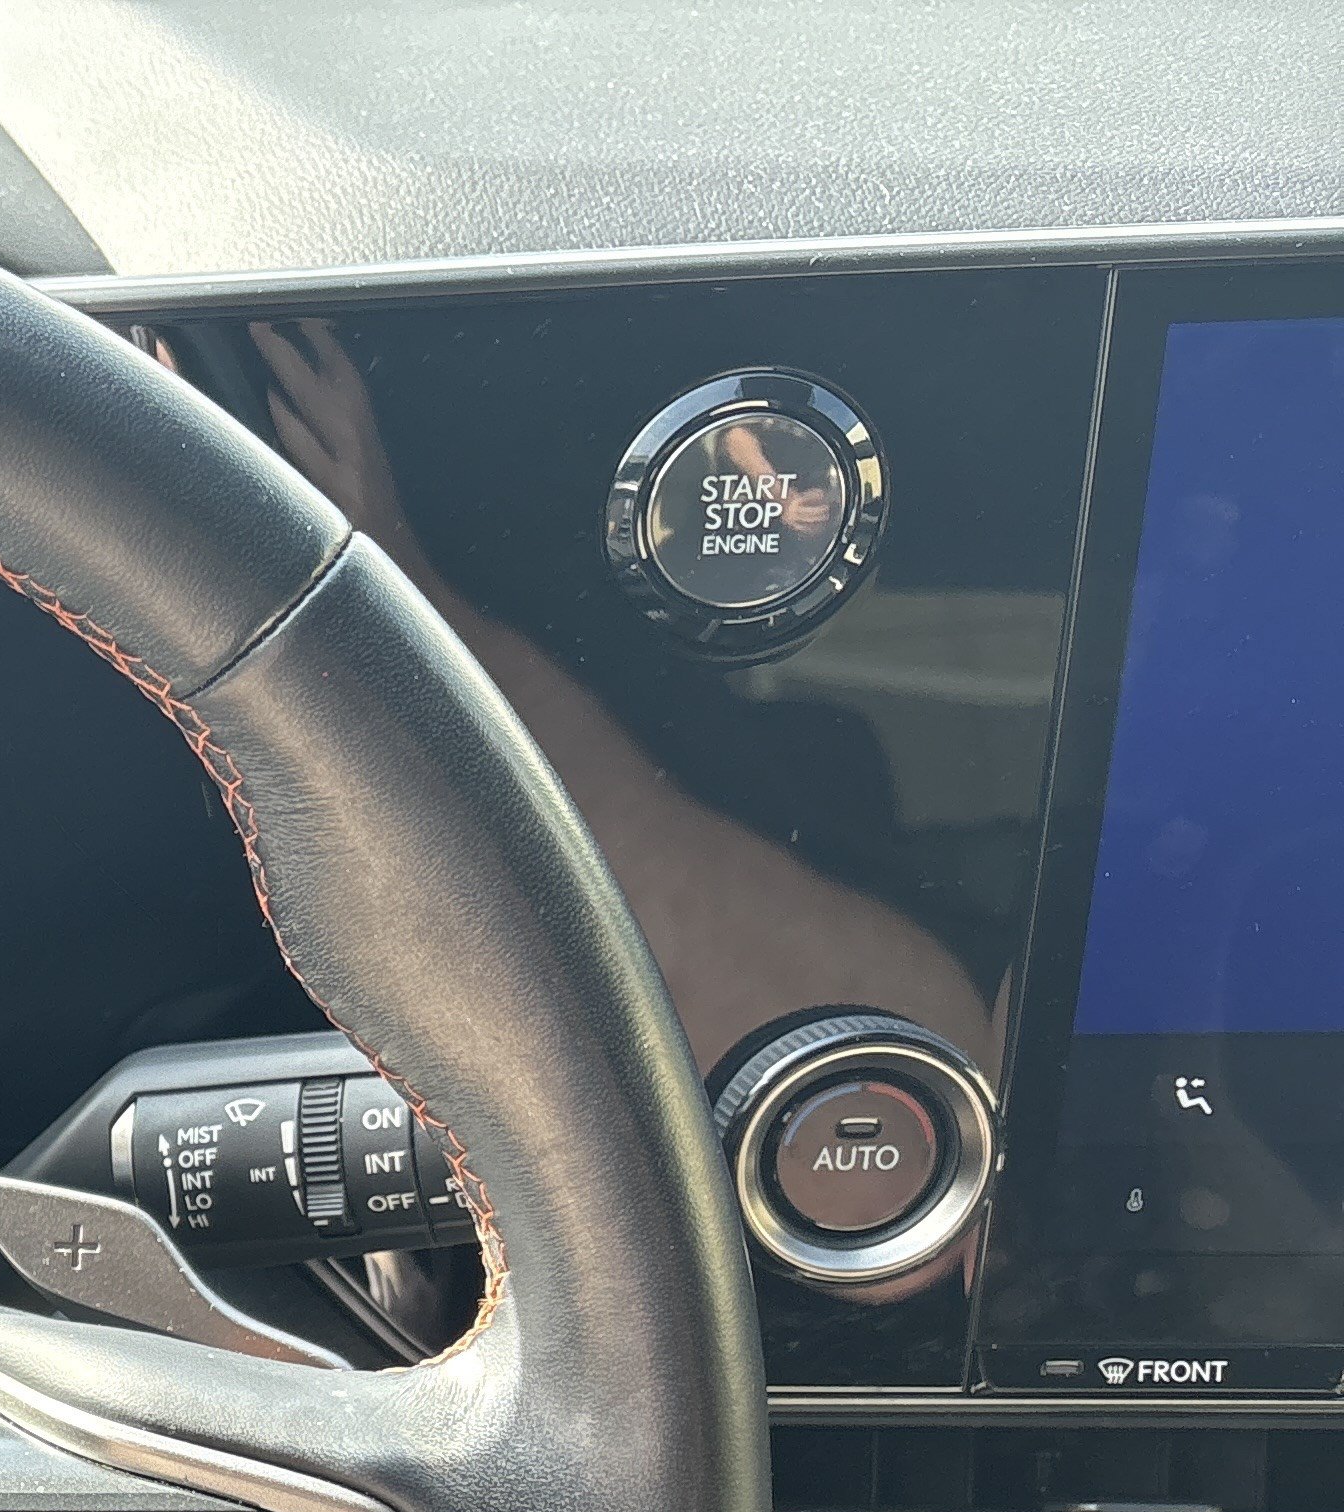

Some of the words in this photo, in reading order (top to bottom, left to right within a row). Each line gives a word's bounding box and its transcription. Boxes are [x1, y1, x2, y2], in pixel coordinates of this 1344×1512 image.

[701, 474, 797, 501] START
[704, 502, 783, 530] STOP
[702, 534, 780, 554] ENGINE
[361, 1107, 403, 1130] ON
[177, 1124, 222, 1146] MIST
[178, 1147, 217, 1167] OFF
[365, 1150, 407, 1174] INT
[813, 1145, 900, 1172] AUTO
[182, 1170, 213, 1189] INT
[250, 1166, 276, 1182] INT
[185, 1194, 213, 1211] LO
[368, 1190, 416, 1212] OFF
[1138, 1359, 1228, 1383] FRONT
